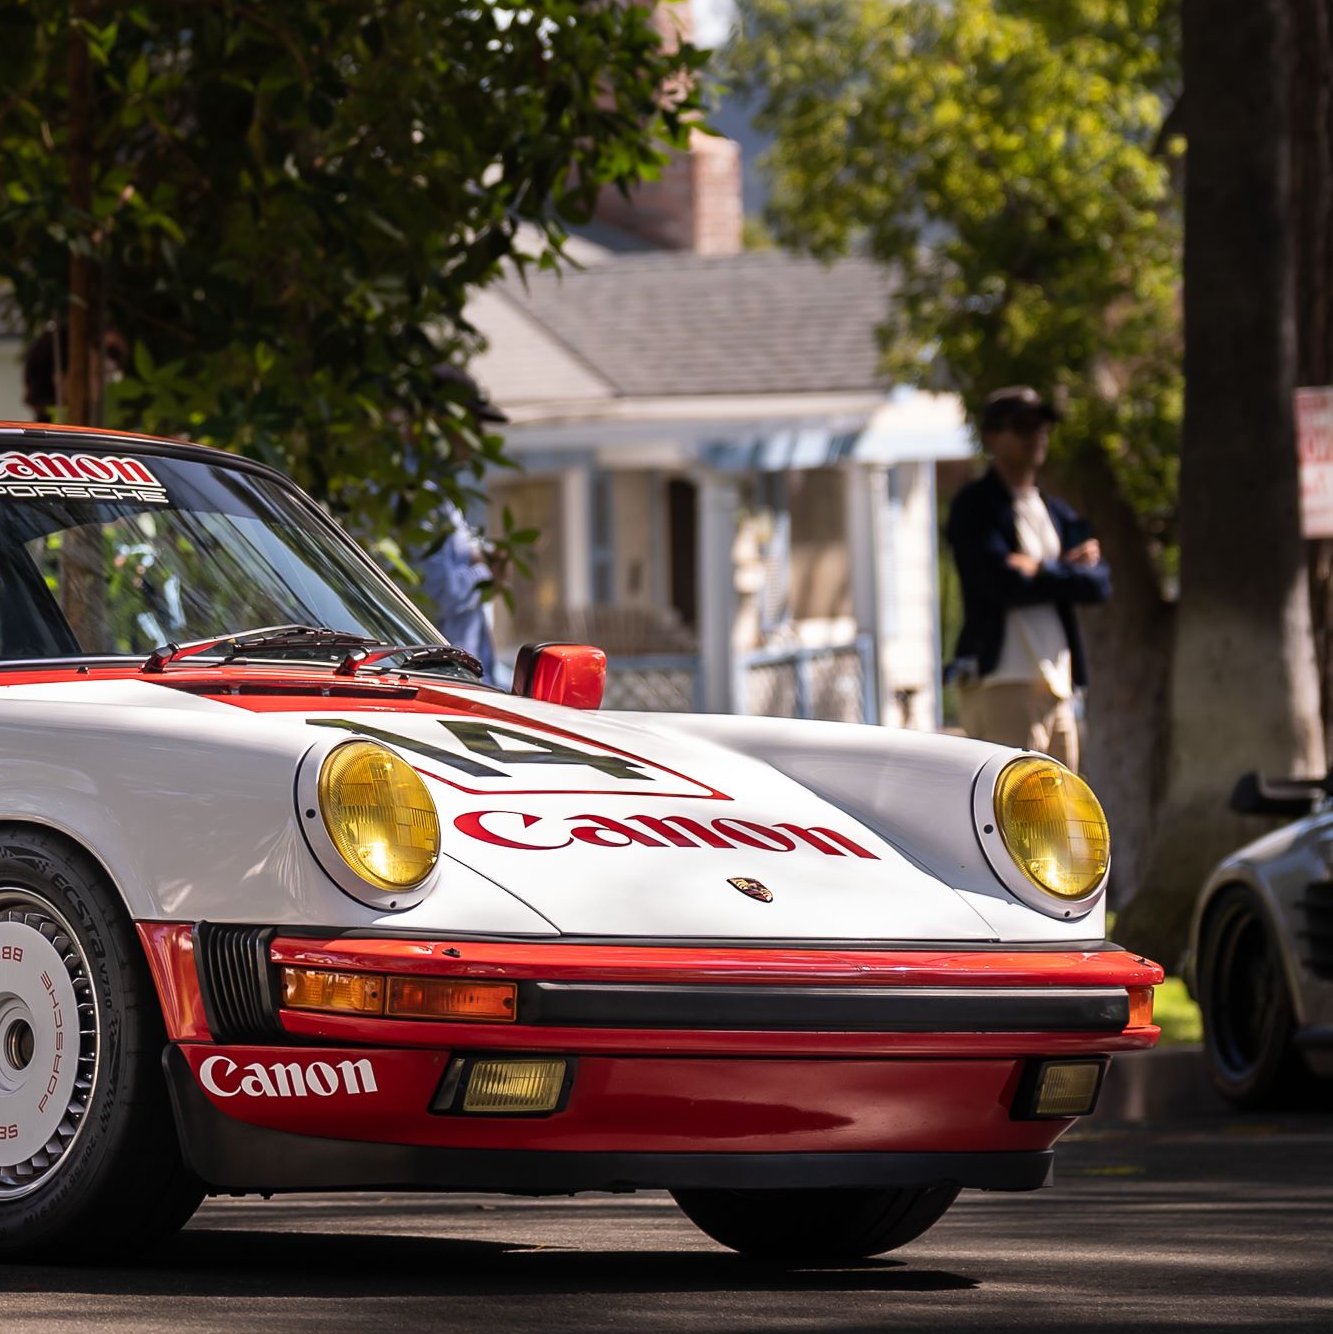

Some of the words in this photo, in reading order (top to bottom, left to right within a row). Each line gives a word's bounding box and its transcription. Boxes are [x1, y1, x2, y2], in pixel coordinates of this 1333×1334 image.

[306, 718, 656, 781] 14
[453, 809, 882, 861] Canon
[38, 970, 65, 1114] PORSCHE
[199, 1055, 378, 1098] Canon
